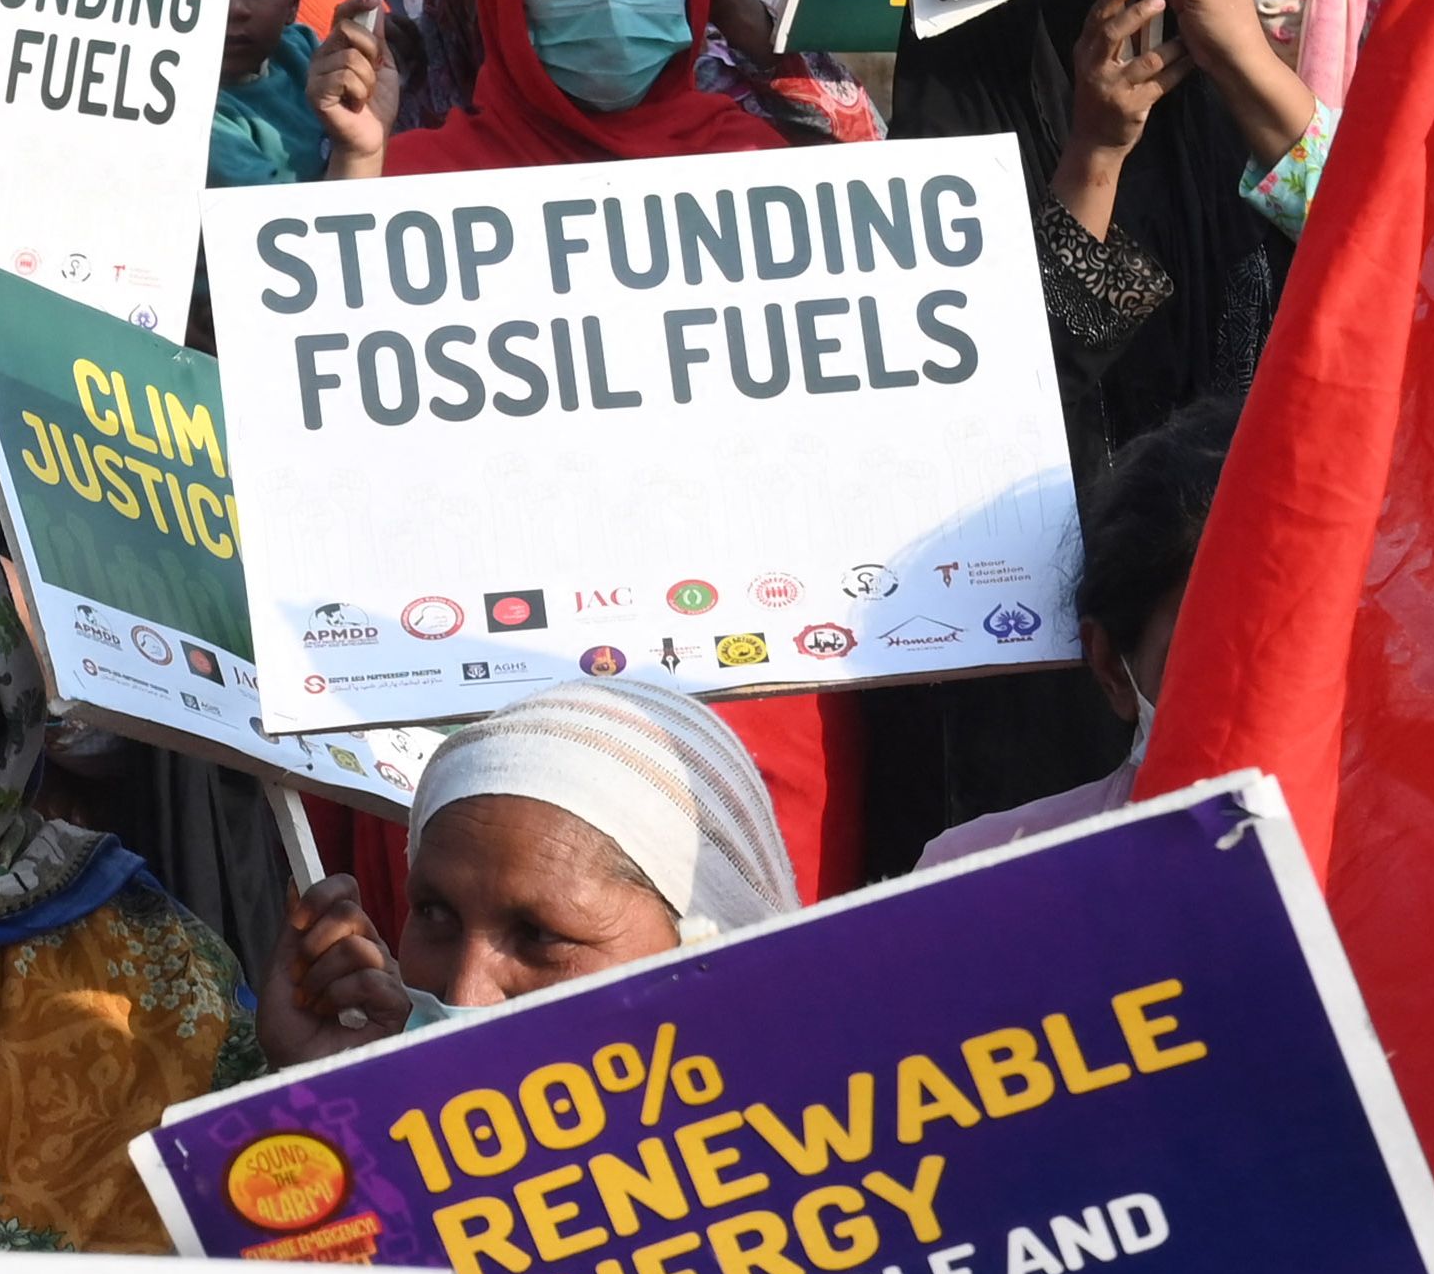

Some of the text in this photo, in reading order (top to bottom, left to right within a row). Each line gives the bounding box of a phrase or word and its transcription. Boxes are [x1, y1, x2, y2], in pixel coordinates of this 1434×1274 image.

[5, 27, 181, 126] FUELS
[255, 175, 984, 315] STOP FUNDING
[293, 289, 978, 431] FOSSIL FUELS
[302, 627, 378, 643] APMDD
[246, 1144, 308, 1174] SOUND
[389, 1022, 725, 1194] 100%
